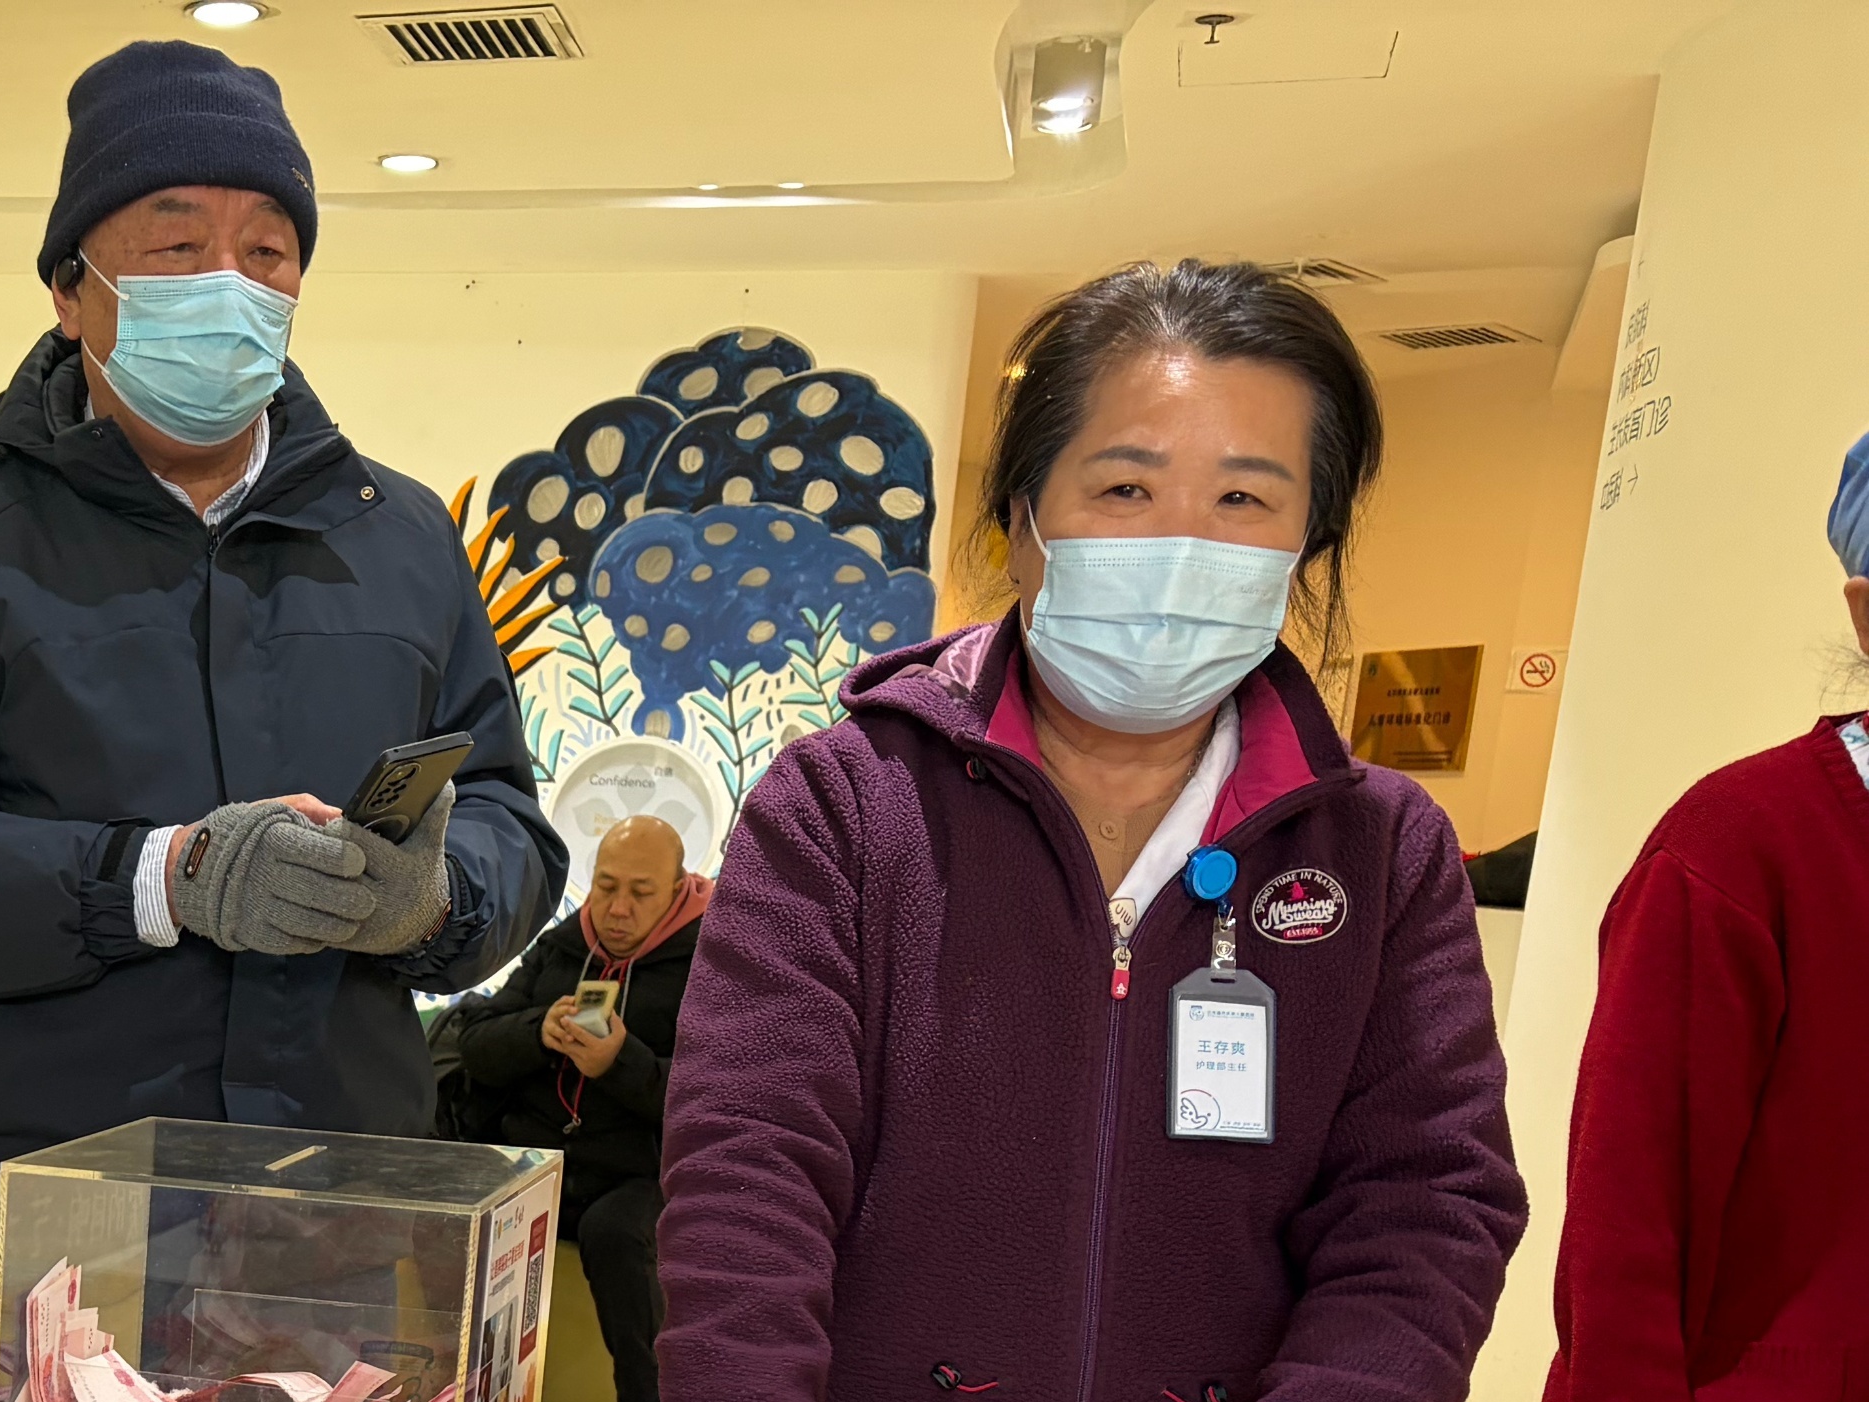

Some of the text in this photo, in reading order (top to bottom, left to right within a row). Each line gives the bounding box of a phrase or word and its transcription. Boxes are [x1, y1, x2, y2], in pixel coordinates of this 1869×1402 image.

[589, 773, 656, 789] Confidence
[1273, 873, 1298, 888] TIME
[1300, 871, 1312, 881] IN
[1313, 874, 1343, 904] NATURE
[1197, 1039, 1246, 1056] 王存爽
[1195, 1061, 1248, 1072] 护理部主任
